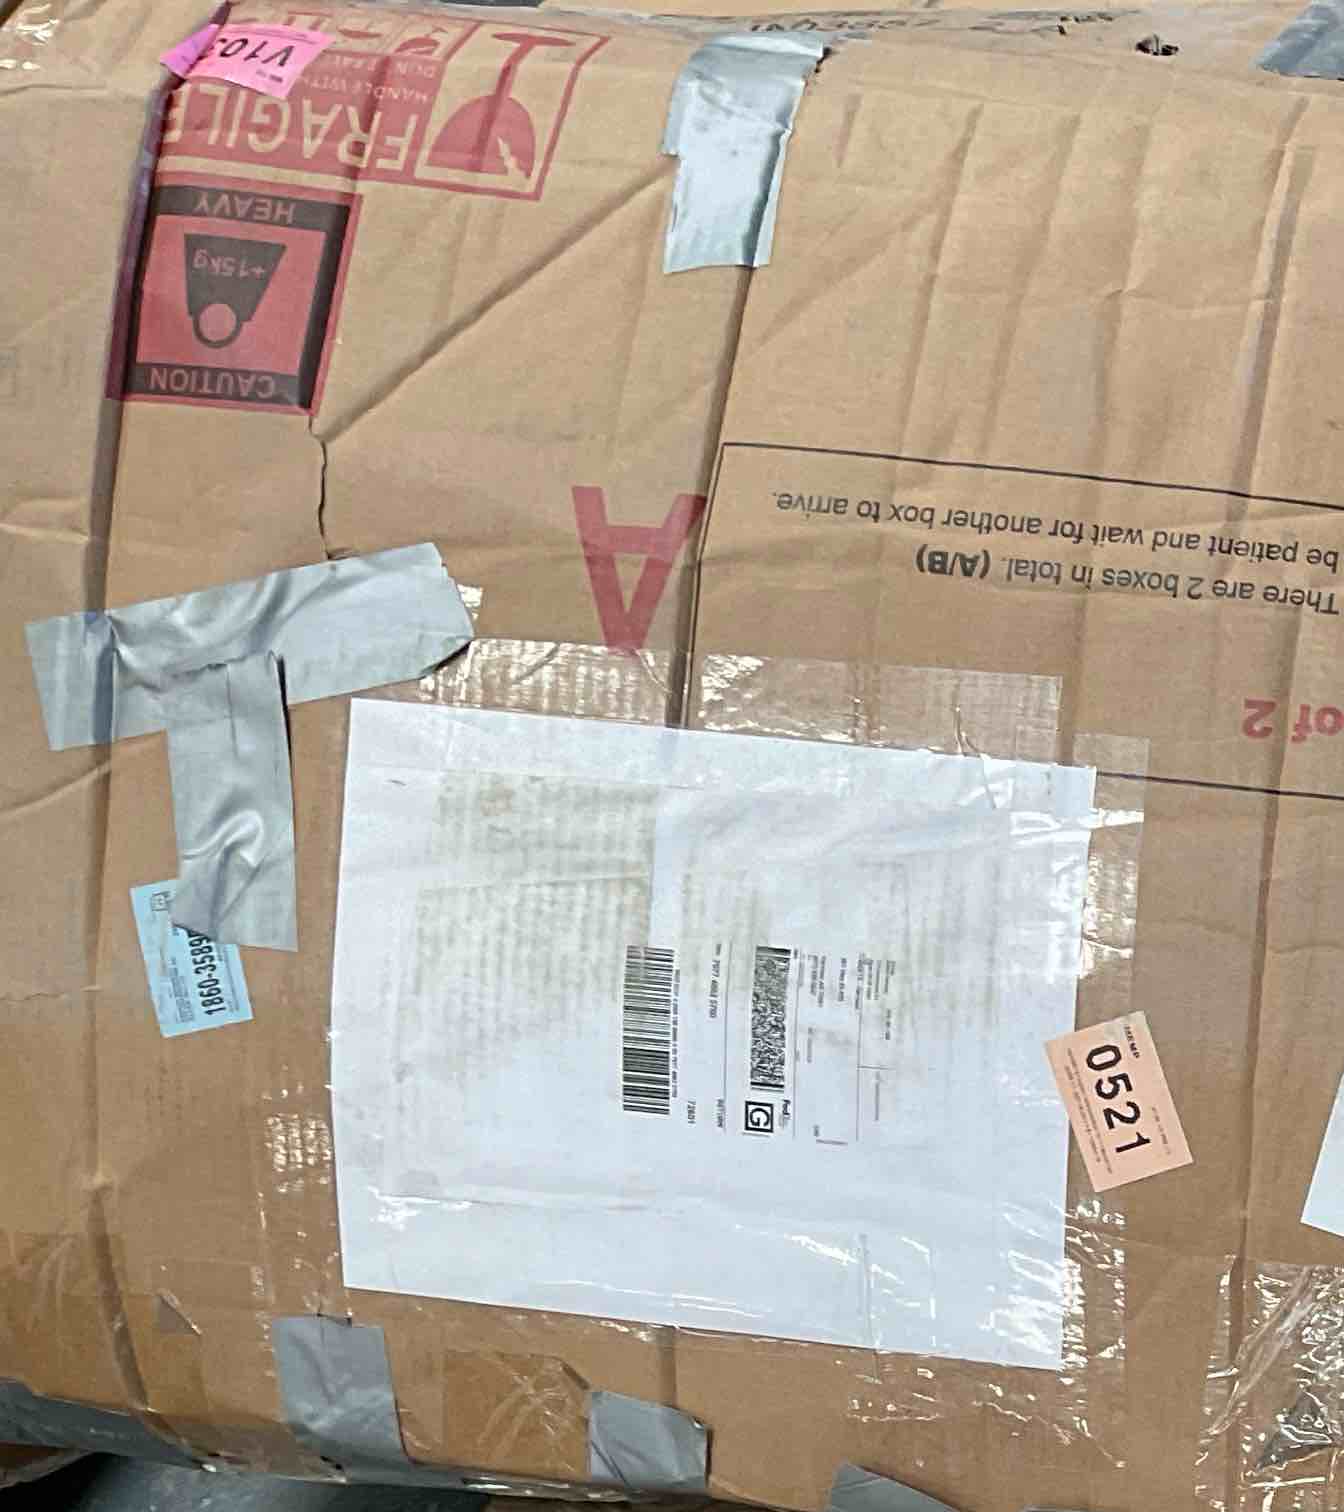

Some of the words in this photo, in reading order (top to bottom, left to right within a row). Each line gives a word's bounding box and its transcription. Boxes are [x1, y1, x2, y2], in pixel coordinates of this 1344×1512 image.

[192, 191, 295, 225] HEAVY
[192, 248, 266, 279] +15kg
[148, 365, 276, 399] CAUTION
[771, 490, 849, 518] arrive.
[856, 499, 881, 524] to
[889, 503, 935, 530] box
[942, 508, 1042, 538] another
[1048, 518, 1084, 545] for
[1090, 523, 1144, 550] wait
[1152, 530, 1201, 555] and
[1208, 533, 1299, 563] patient
[572, 485, 705, 657] A
[915, 543, 991, 580] (A/B)
[1000, 557, 1062, 585] total.
[1306, 549, 1338, 575] be
[1071, 564, 1093, 590] in
[1102, 567, 1179, 596] boxes
[1187, 576, 1204, 600] 2
[1212, 579, 1255, 601] are
[1262, 584, 1339, 615] There
[1243, 697, 1277, 740] 2
[1292, 703, 1344, 744] of
[188, 929, 226, 1015] 1860-3589
[1086, 1044, 1151, 1153] 0521
[749, 1107, 771, 1127] G
